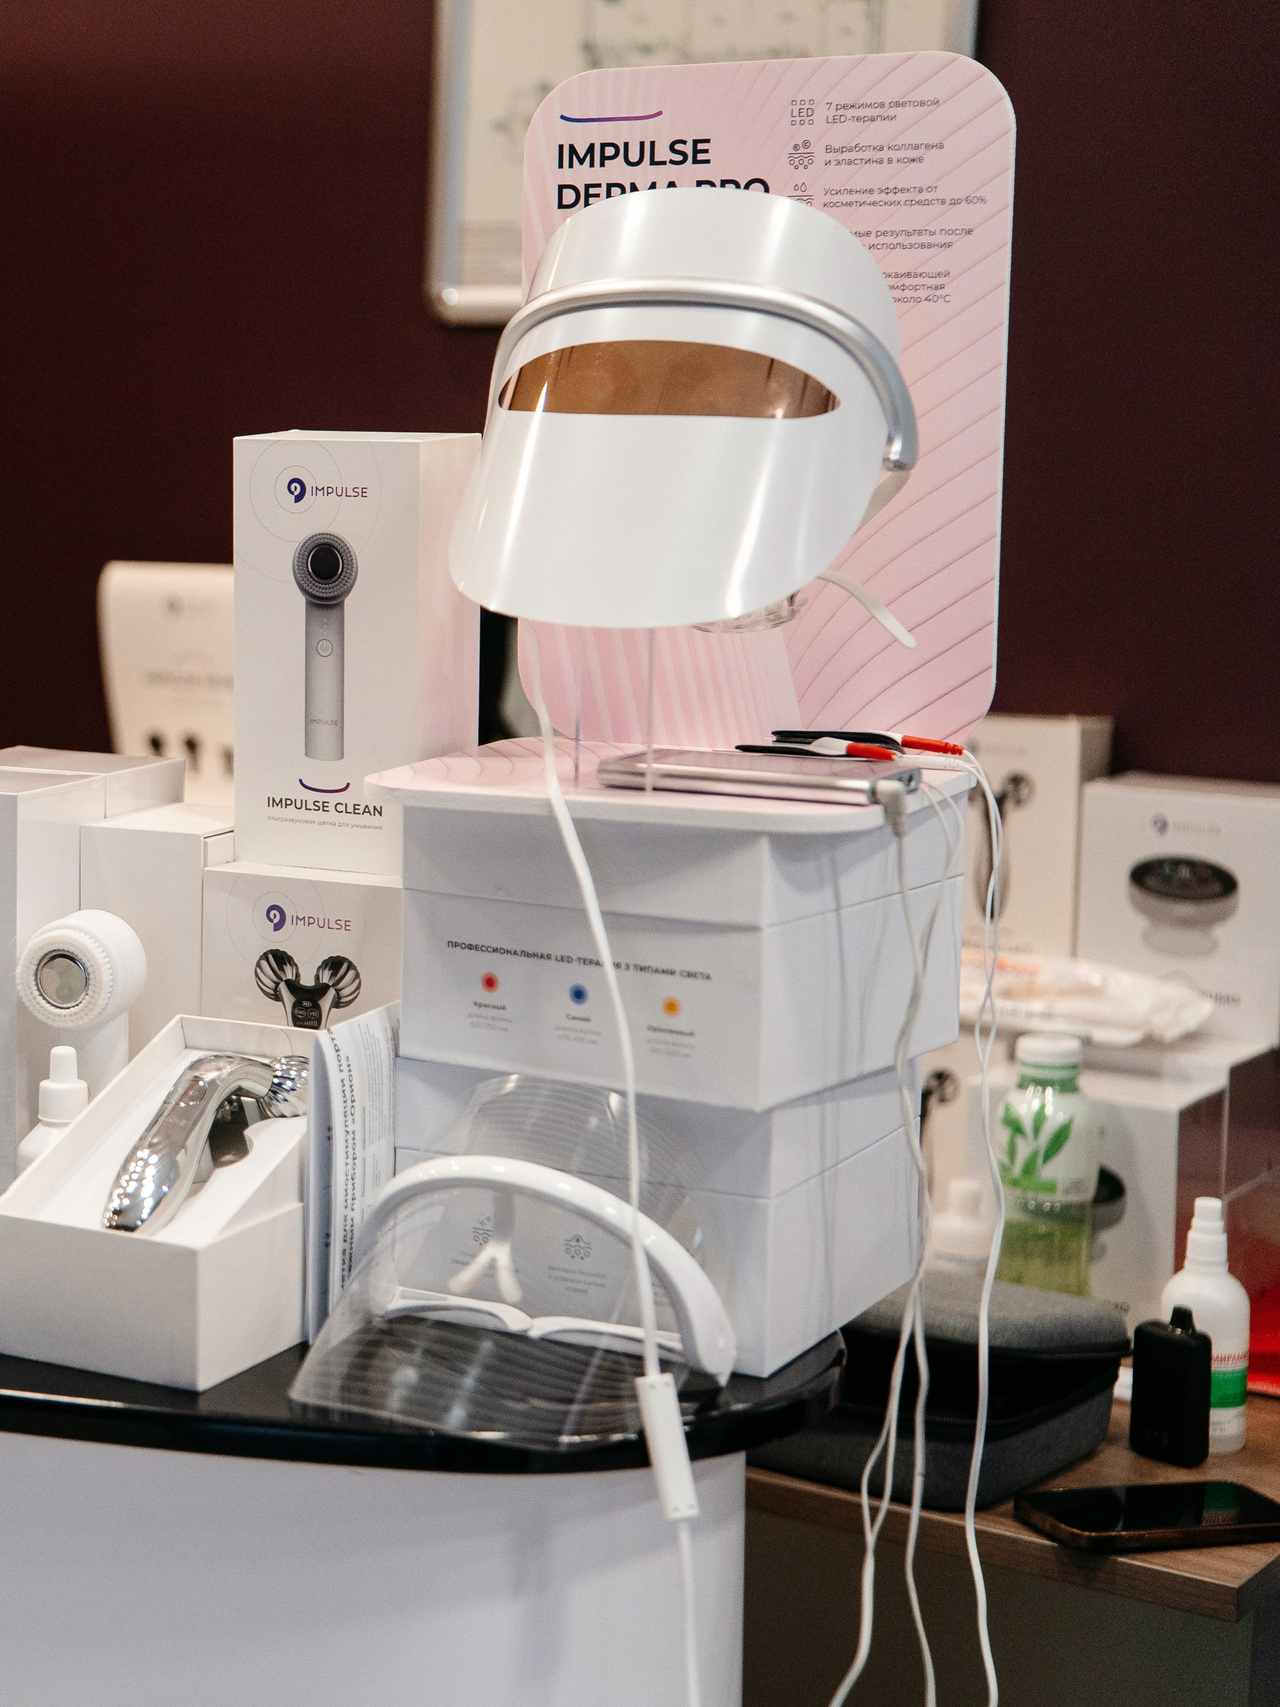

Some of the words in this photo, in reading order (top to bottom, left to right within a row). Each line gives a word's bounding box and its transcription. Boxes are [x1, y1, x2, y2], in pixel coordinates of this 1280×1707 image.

[826, 102, 833, 111] 7
[835, 101, 886, 112] режимов
[888, 97, 940, 108] световой
[791, 107, 815, 118] LED
[825, 113, 897, 124] LED-терапии
[557, 138, 712, 170] IMPULSE
[824, 144, 885, 155] Выработка
[887, 141, 945, 152] коллагена
[824, 158, 832, 167] и
[834, 156, 885, 167] эластина
[887, 156, 894, 164] в
[896, 154, 925, 165] коже
[823, 186, 875, 196] Усиление
[877, 185, 924, 196] эффекта
[926, 185, 938, 194] от
[823, 198, 902, 209] косметических
[904, 196, 948, 208] средств
[949, 197, 963, 207] до
[965, 195, 988, 205] 60%
[875, 228, 937, 239] результаты
[939, 227, 974, 237] после
[868, 241, 954, 251] использования
[311, 485, 368, 498] IMPULSE
[267, 796, 330, 812] IMPULSE
[334, 802, 383, 817] CLEAN
[267, 815, 316, 825] Ультразвуковая
[291, 914, 352, 932] IMPULSE
[447, 940, 552, 961] ПРОФЕССИОНАЛЬНАЯ
[633, 962, 677, 976] ТИПАМИ
[680, 969, 713, 981] СВЕТА
[473, 1001, 507, 1011] Красный
[346, 1055, 357, 1125] «Орион»
[340, 1078, 350, 1210] миостимуляции
[350, 1129, 358, 1212] прибором
